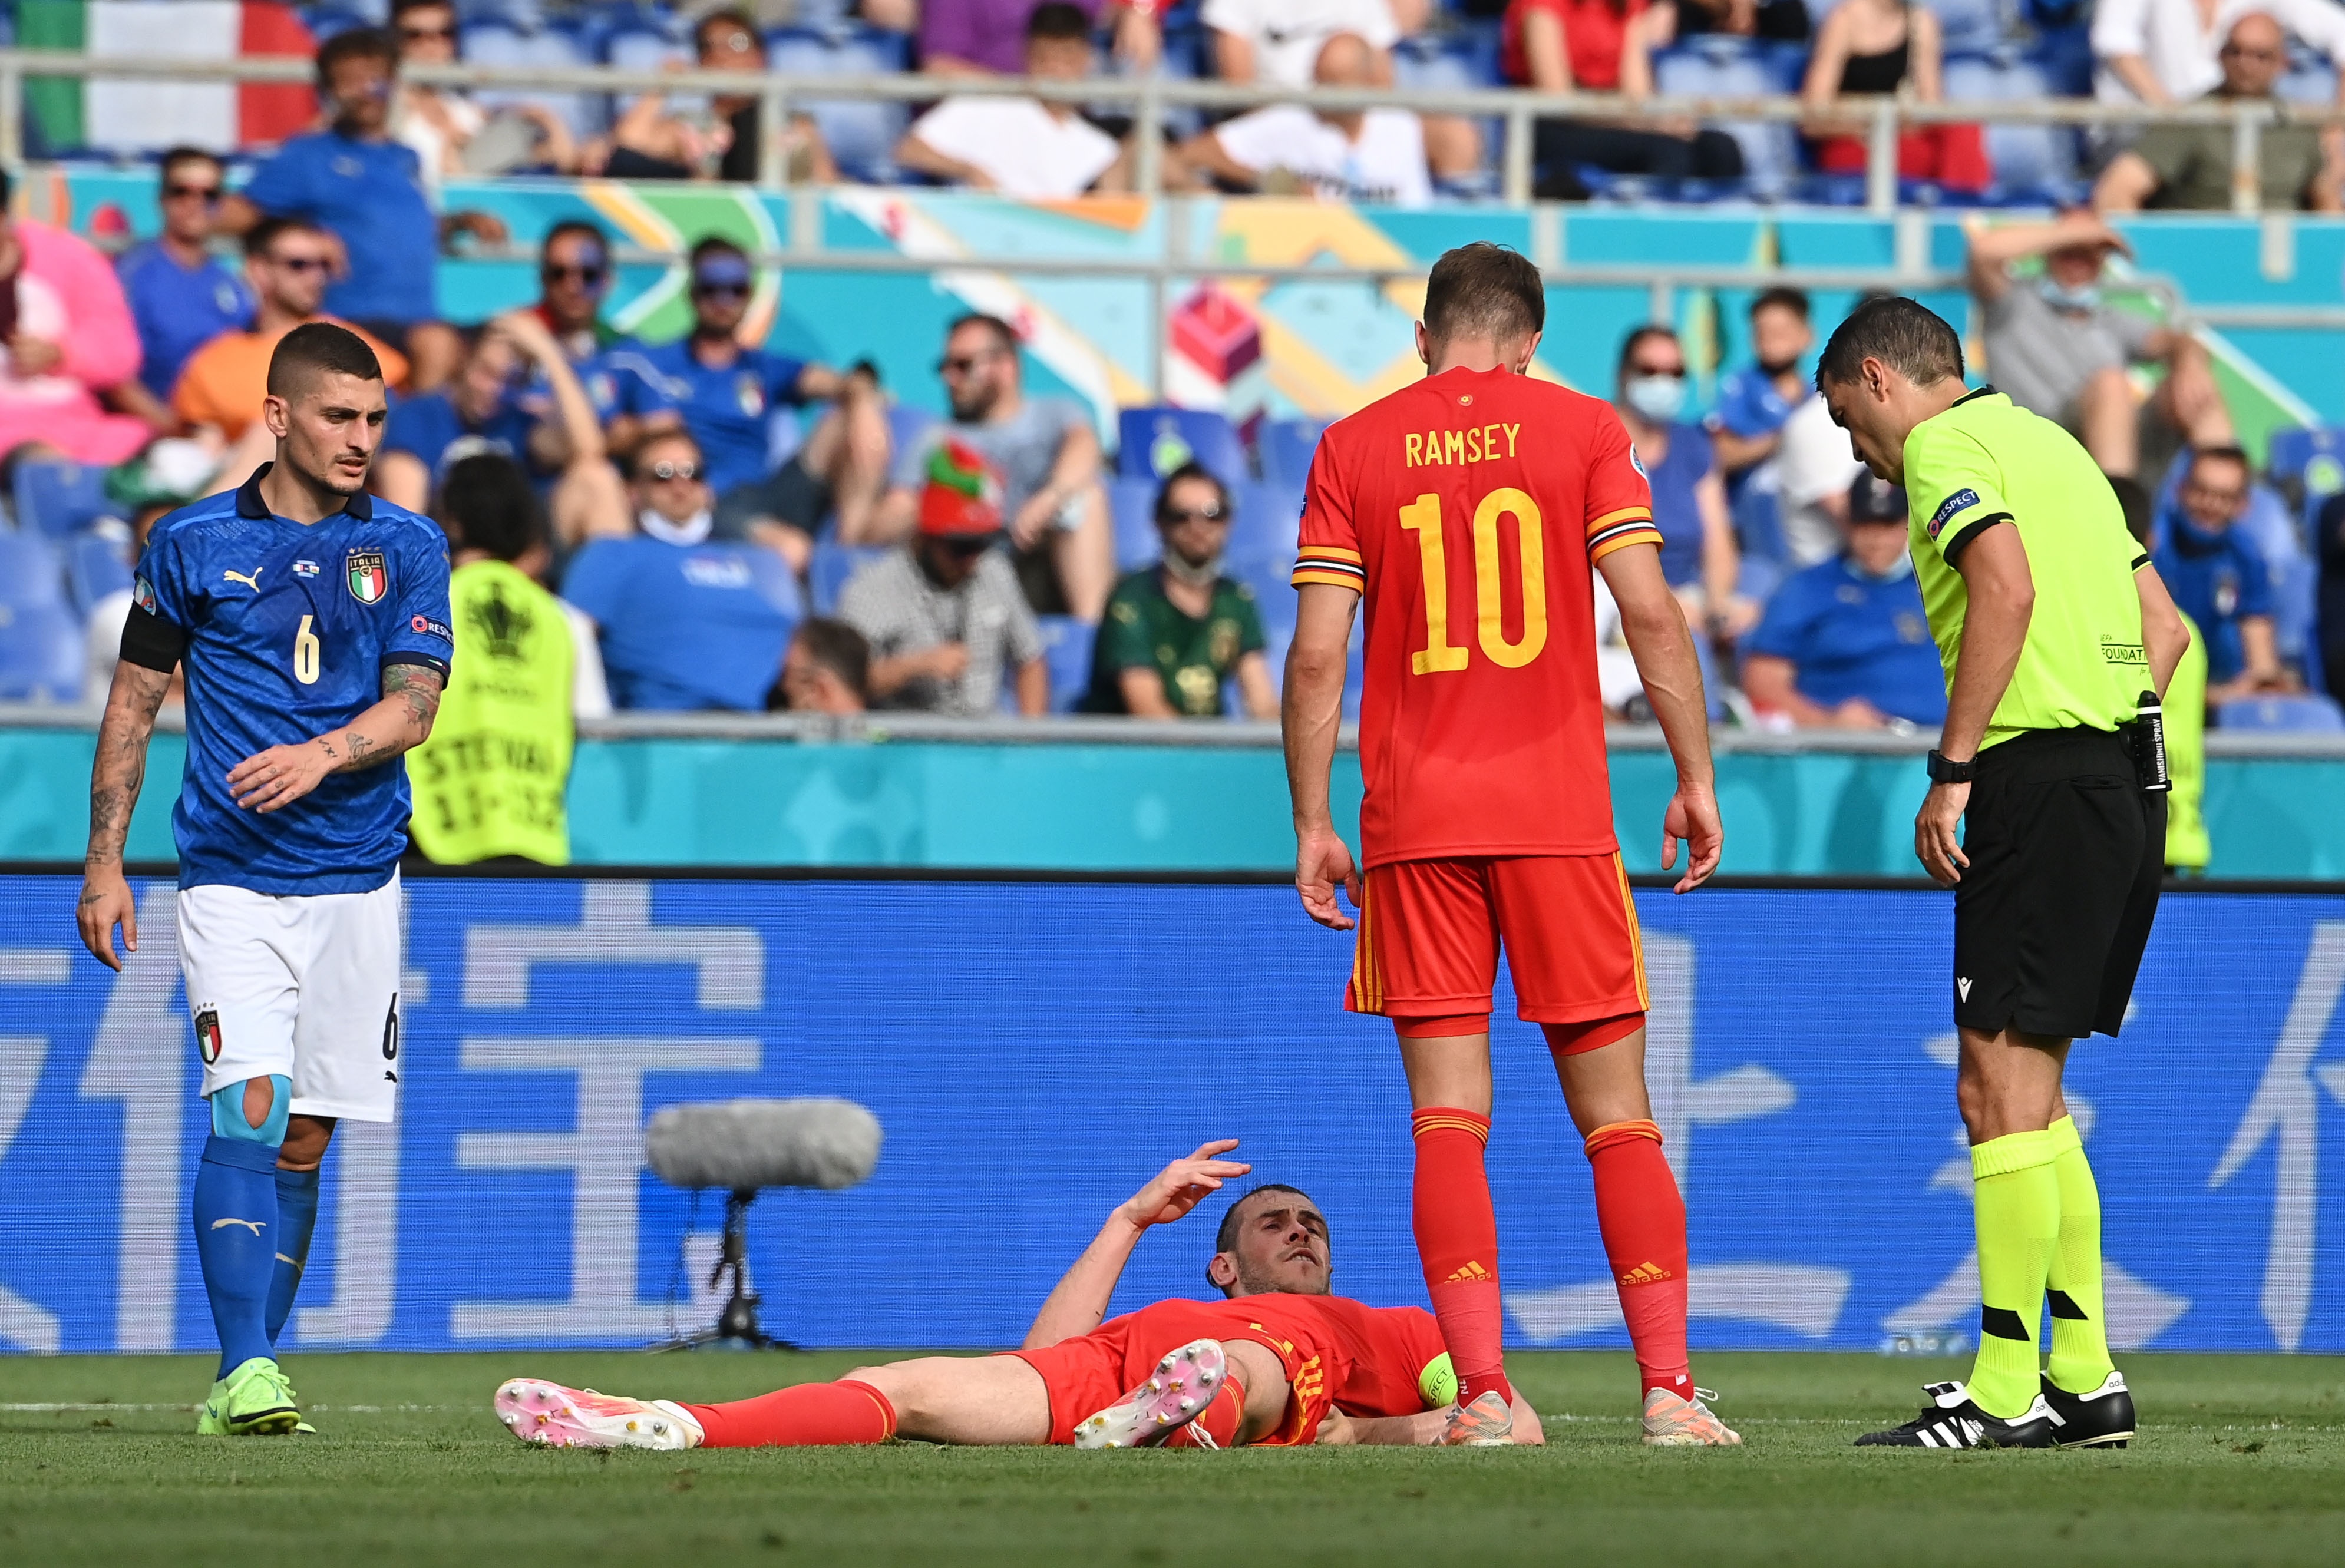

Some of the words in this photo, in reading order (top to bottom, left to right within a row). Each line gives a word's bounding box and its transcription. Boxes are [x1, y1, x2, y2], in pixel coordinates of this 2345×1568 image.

[1405, 423, 1520, 468] RAMSEY
[1937, 491, 1976, 522] RESPECT
[349, 557, 380, 567] ITALIA
[1399, 487, 1547, 676] 10
[294, 614, 320, 685] 6
[2152, 719, 2162, 742] SPRAY
[382, 992, 398, 1060] 6
[1620, 1270, 1672, 1285] adidas
